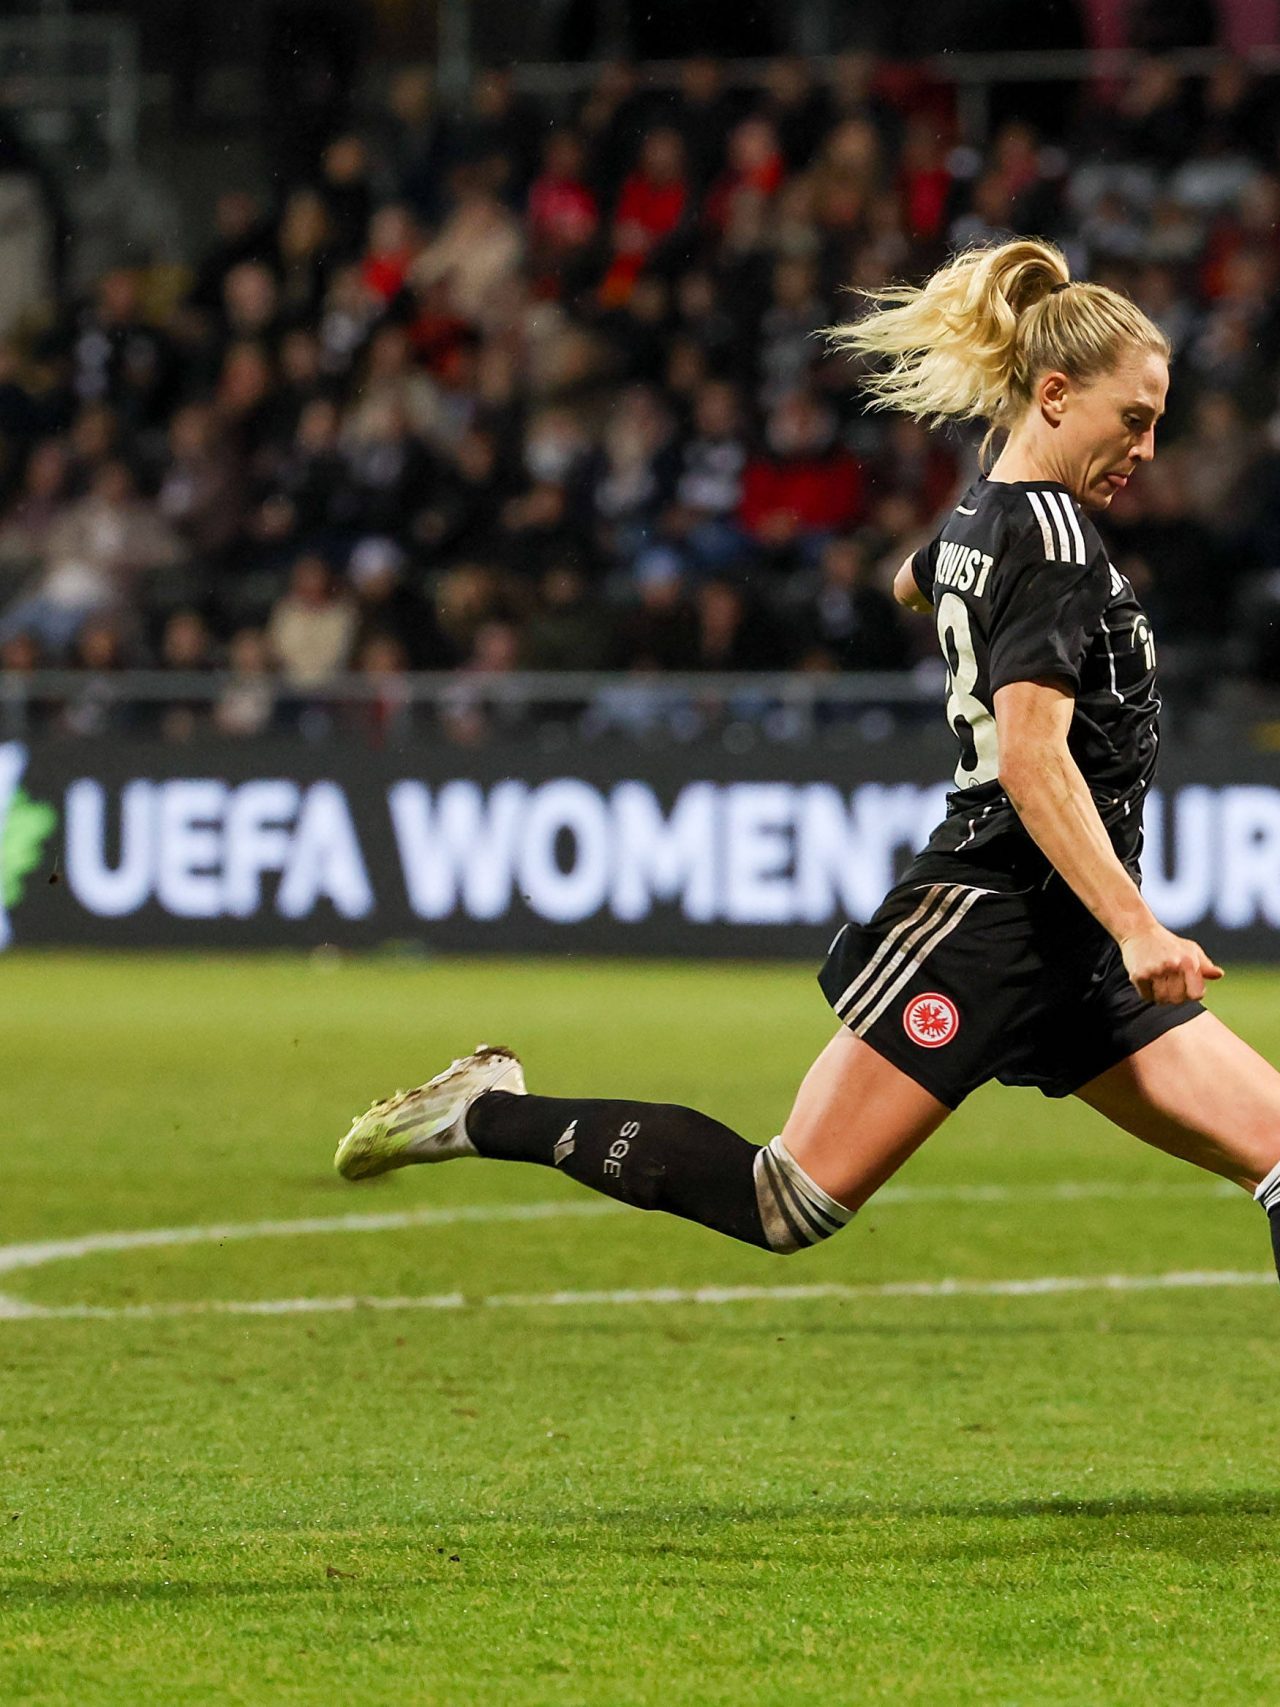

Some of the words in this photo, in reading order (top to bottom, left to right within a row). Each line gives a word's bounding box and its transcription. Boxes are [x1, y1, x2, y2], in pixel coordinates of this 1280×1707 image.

[937, 592, 998, 791] 8
[65, 778, 373, 919] UEFA
[603, 1121, 641, 1178] SGE
